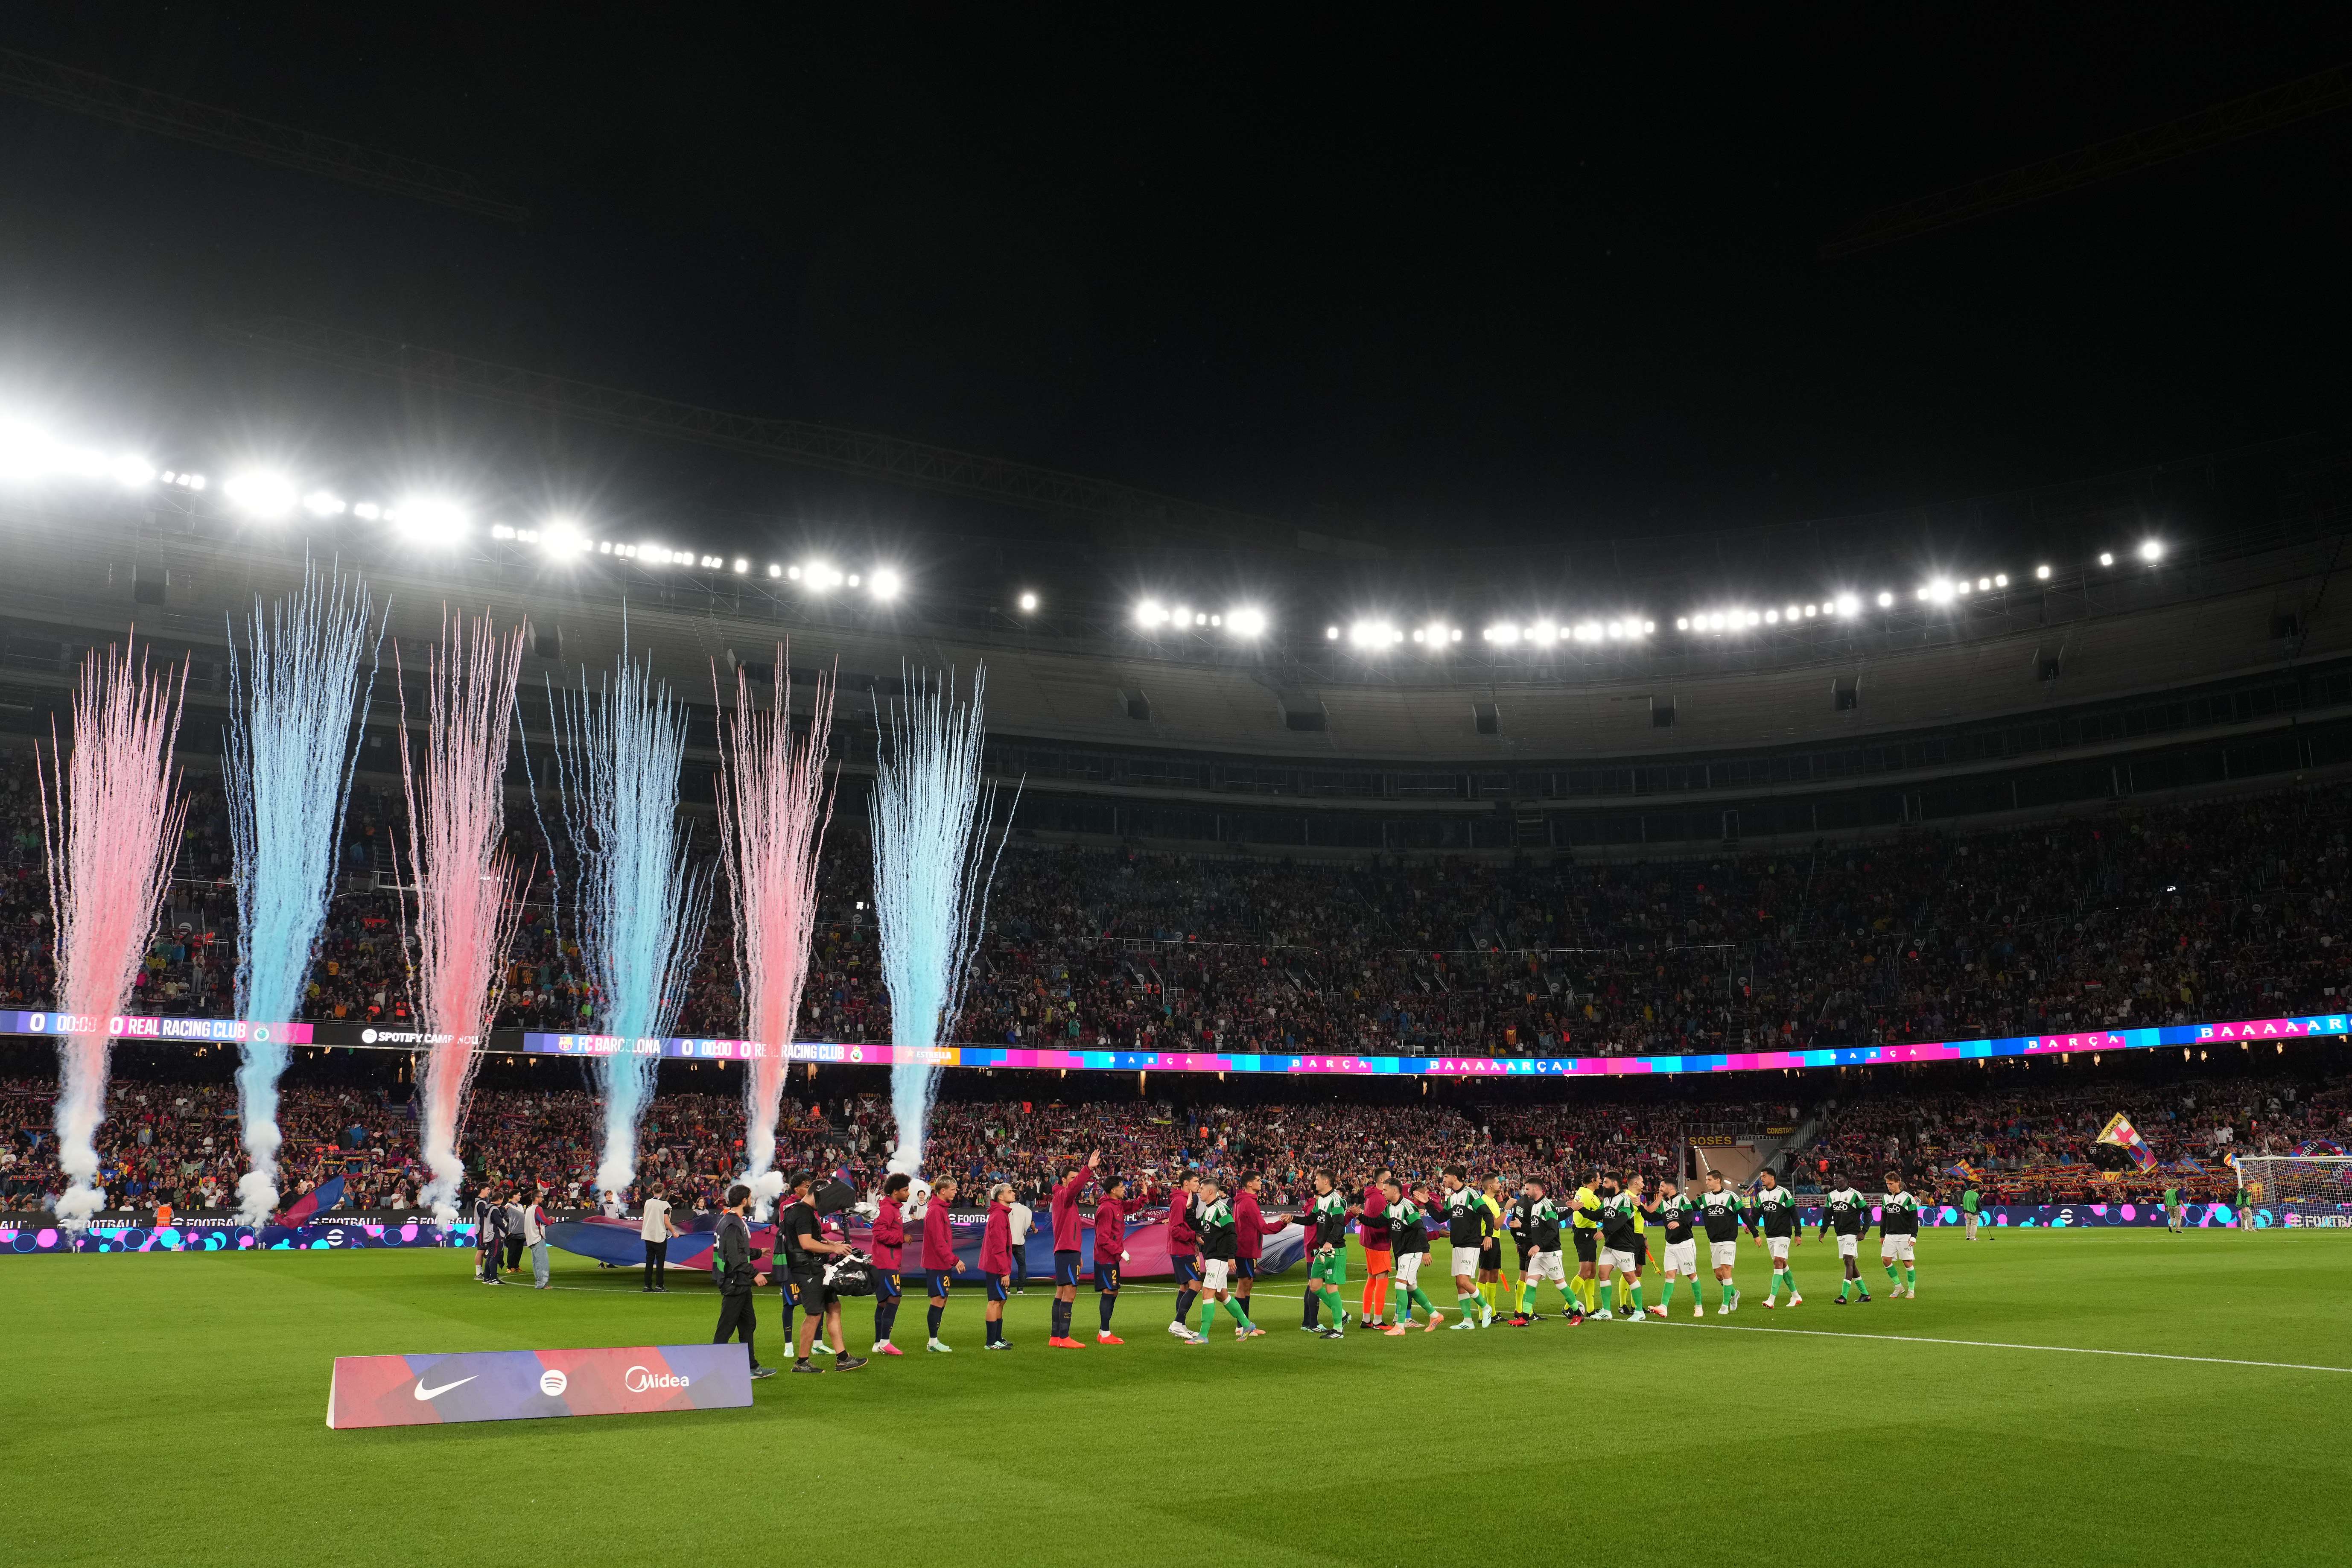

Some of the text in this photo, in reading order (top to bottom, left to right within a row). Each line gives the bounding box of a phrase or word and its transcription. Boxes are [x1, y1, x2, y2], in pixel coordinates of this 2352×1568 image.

[30, 1013, 45, 1031] 0
[110, 1017, 123, 1034] 0
[2200, 1018, 2352, 1038] BAAAAAR
[128, 1019, 246, 1039] REAL RACING CLUB
[378, 1032, 423, 1043] SPOTIFY
[424, 1034, 453, 1044] CAMP
[2028, 1035, 2119, 1049] BARÇA
[578, 1037, 661, 1054] FC BARCELONA
[682, 1042, 693, 1056] 0
[701, 1042, 732, 1057] 00:00
[740, 1042, 751, 1057] 0
[781, 1044, 817, 1059] RACING
[819, 1045, 844, 1060] CLUB
[1830, 1049, 1916, 1059] BARÇA
[1109, 1057, 1192, 1065] BARÇA
[1292, 1059, 1367, 1069] BARÇA
[1430, 1060, 1573, 1072] BAAAAARÇA!
[1689, 1136, 1732, 1146] SOSES
[1708, 1206, 1724, 1215] SRCD
[1833, 1202, 1848, 1210] SRCD
[891, 1274, 900, 1285] 14
[1112, 1270, 1117, 1280] 2
[790, 1283, 800, 1294] 10
[625, 1365, 689, 1393] Midea
